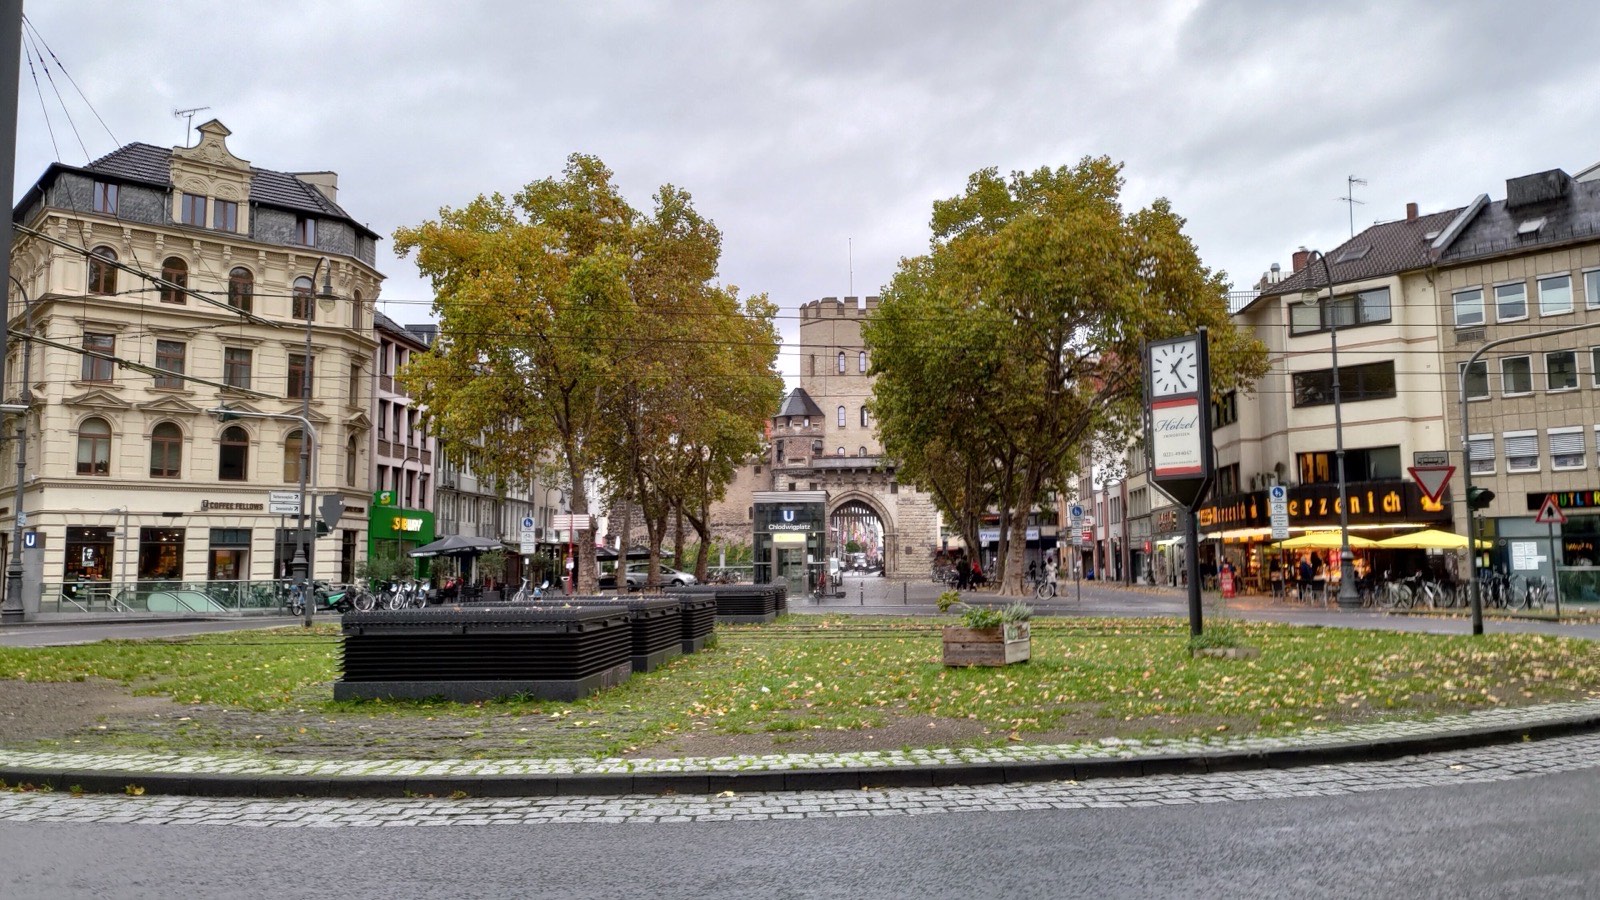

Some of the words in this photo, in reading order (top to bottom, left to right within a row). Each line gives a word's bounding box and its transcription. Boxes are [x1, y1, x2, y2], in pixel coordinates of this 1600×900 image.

[209, 501, 234, 510] COFFEE
[235, 502, 264, 511] FELLOWS
[1267, 491, 1400, 516] erzenich
[783, 510, 795, 522] U
[768, 523, 811, 532] Chlodwigplatz
[25, 534, 36, 547] U
